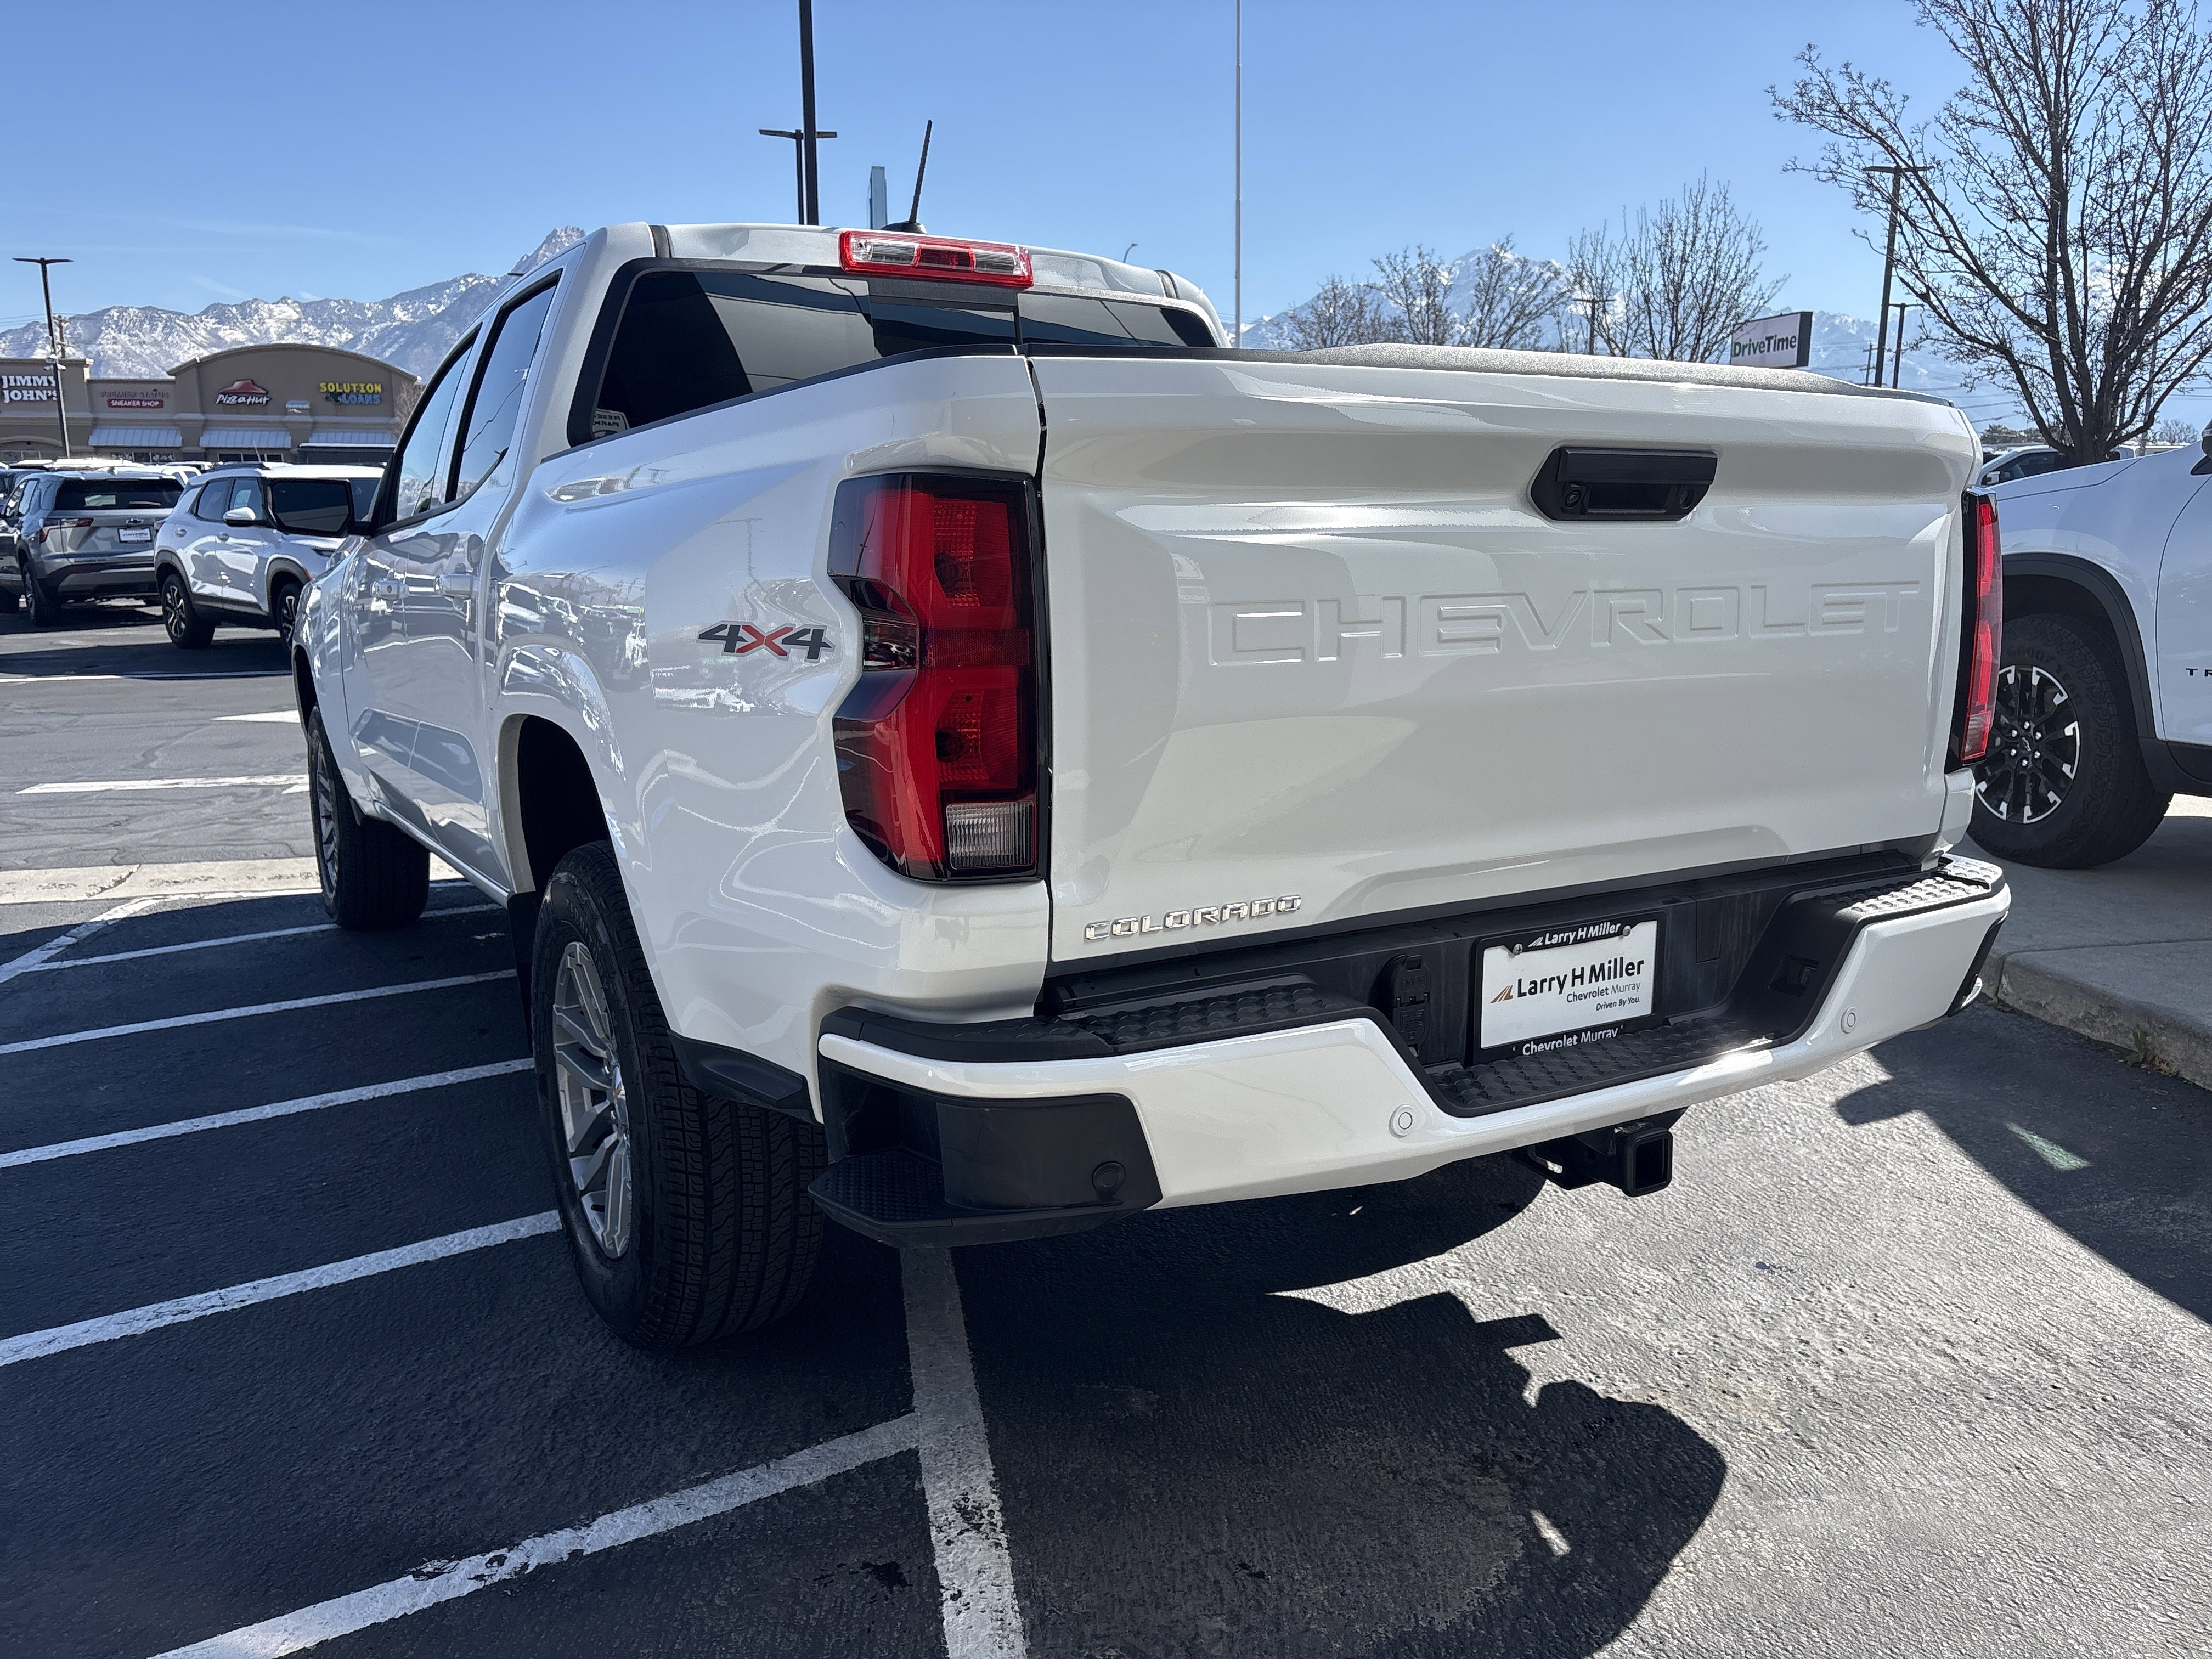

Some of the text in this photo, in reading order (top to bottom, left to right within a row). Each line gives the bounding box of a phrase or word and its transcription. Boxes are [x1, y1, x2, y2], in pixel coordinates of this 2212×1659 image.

[1733, 334, 1797, 357] DriveTime
[1, 375, 55, 388] JIMMY
[319, 382, 382, 393] SOLUTION
[3, 390, 57, 403] JOHN'S
[342, 393, 380, 404] LOANS
[1207, 581, 1920, 666] CHEVROLET
[1085, 894, 1302, 940] COLORADO
[1545, 922, 1621, 944] Larry H Miller
[1517, 956, 1645, 998] Larry H Miller
[1566, 982, 1641, 1003] Chevrolet Murray
[1596, 1001, 1617, 1011] Driven
[1618, 998, 1627, 1008] By
[1522, 1034, 1578, 1056] Chevrolet
